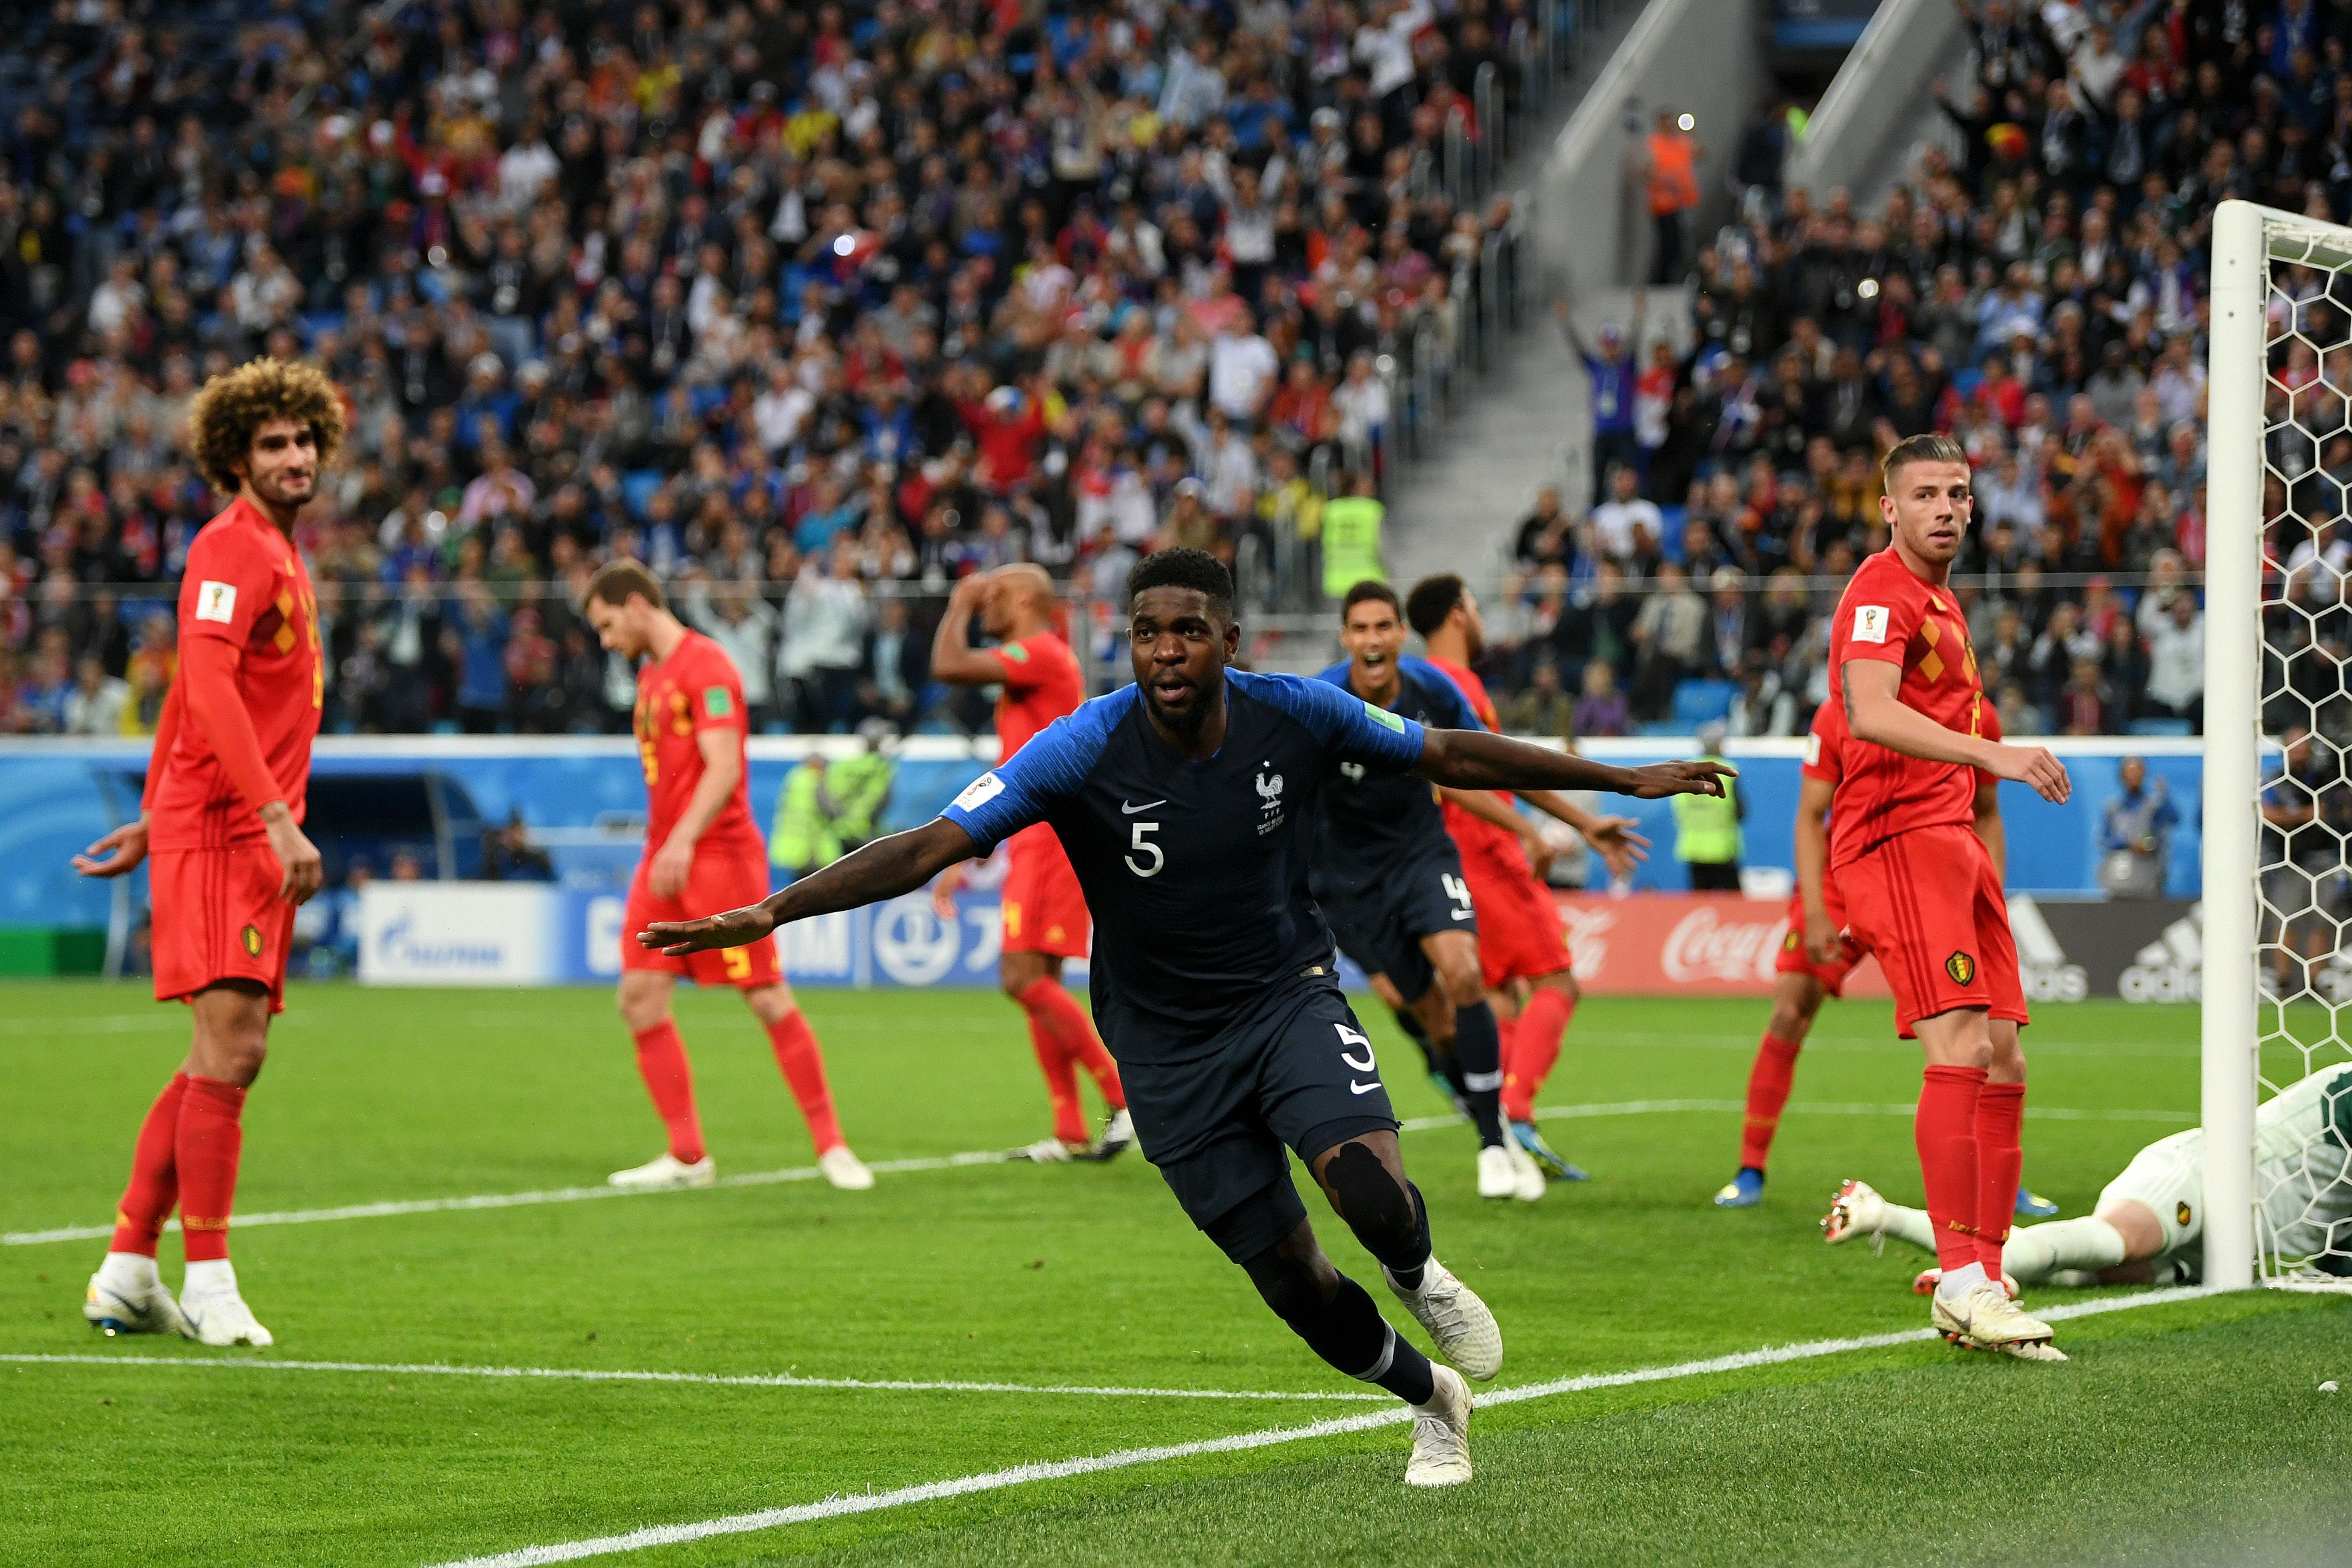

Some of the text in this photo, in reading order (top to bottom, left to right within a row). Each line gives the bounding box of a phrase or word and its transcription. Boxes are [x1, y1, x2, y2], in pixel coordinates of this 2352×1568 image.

[1124, 822, 1164, 878] 5
[1440, 872, 1472, 910] 4
[721, 946, 752, 980] 5
[1334, 1023, 1376, 1072] 5
